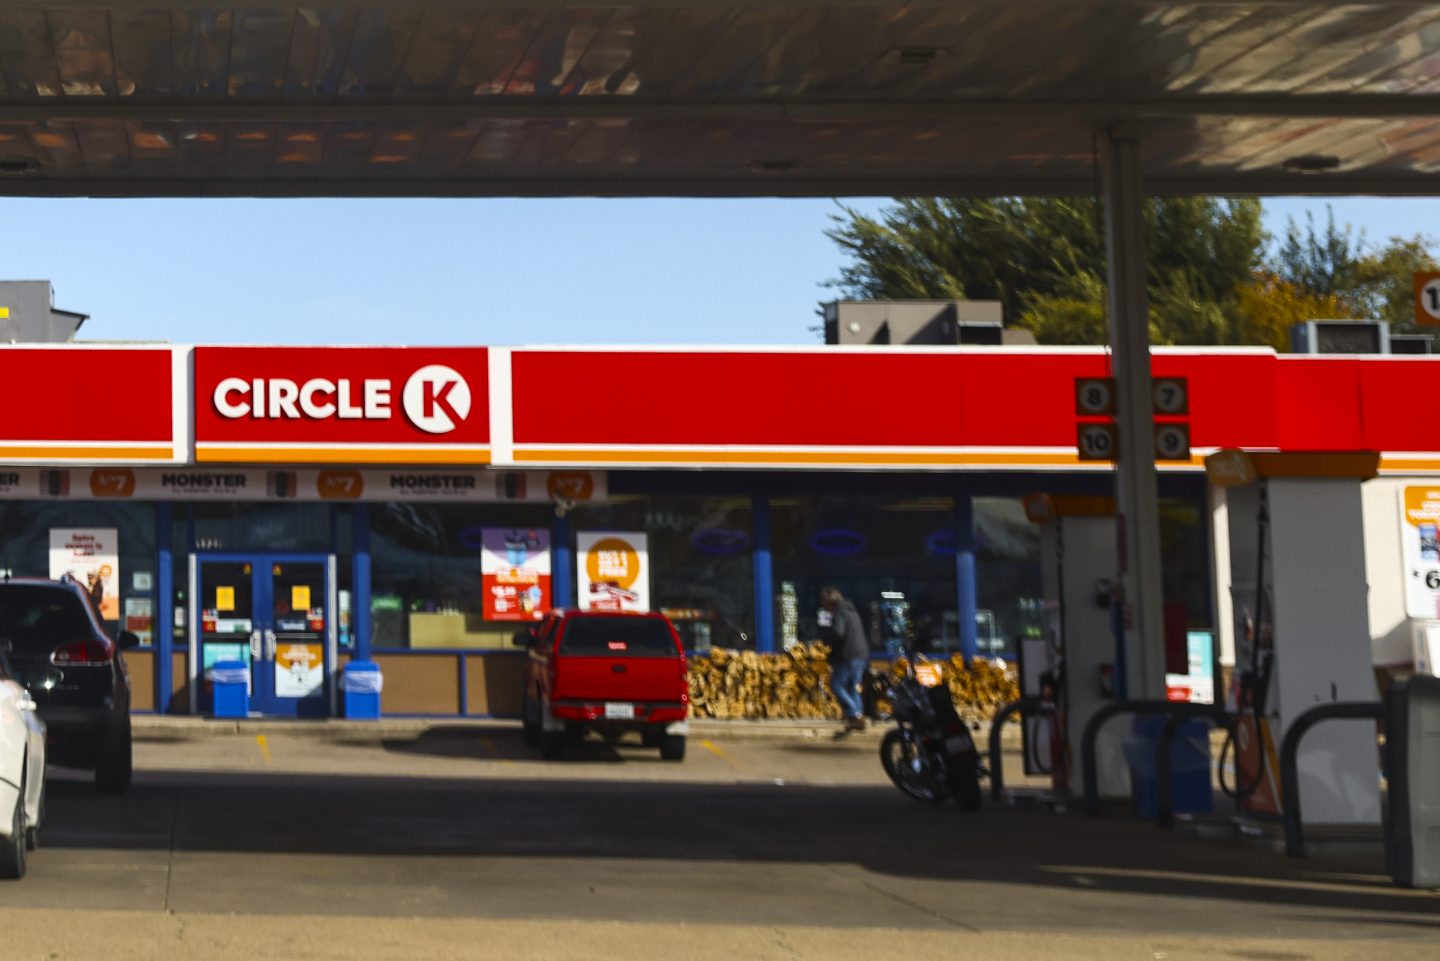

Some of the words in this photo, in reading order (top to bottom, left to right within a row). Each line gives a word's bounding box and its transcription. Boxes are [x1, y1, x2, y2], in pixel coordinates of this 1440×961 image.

[213, 377, 391, 419] CIRCLE
[422, 380, 466, 429] K
[1087, 388, 1101, 406] 8
[1161, 387, 1175, 405] 7
[1085, 433, 1109, 452] 10
[1164, 433, 1179, 451] 9
[161, 473, 246, 488] MONSTER
[390, 475, 475, 489] MONSTER
